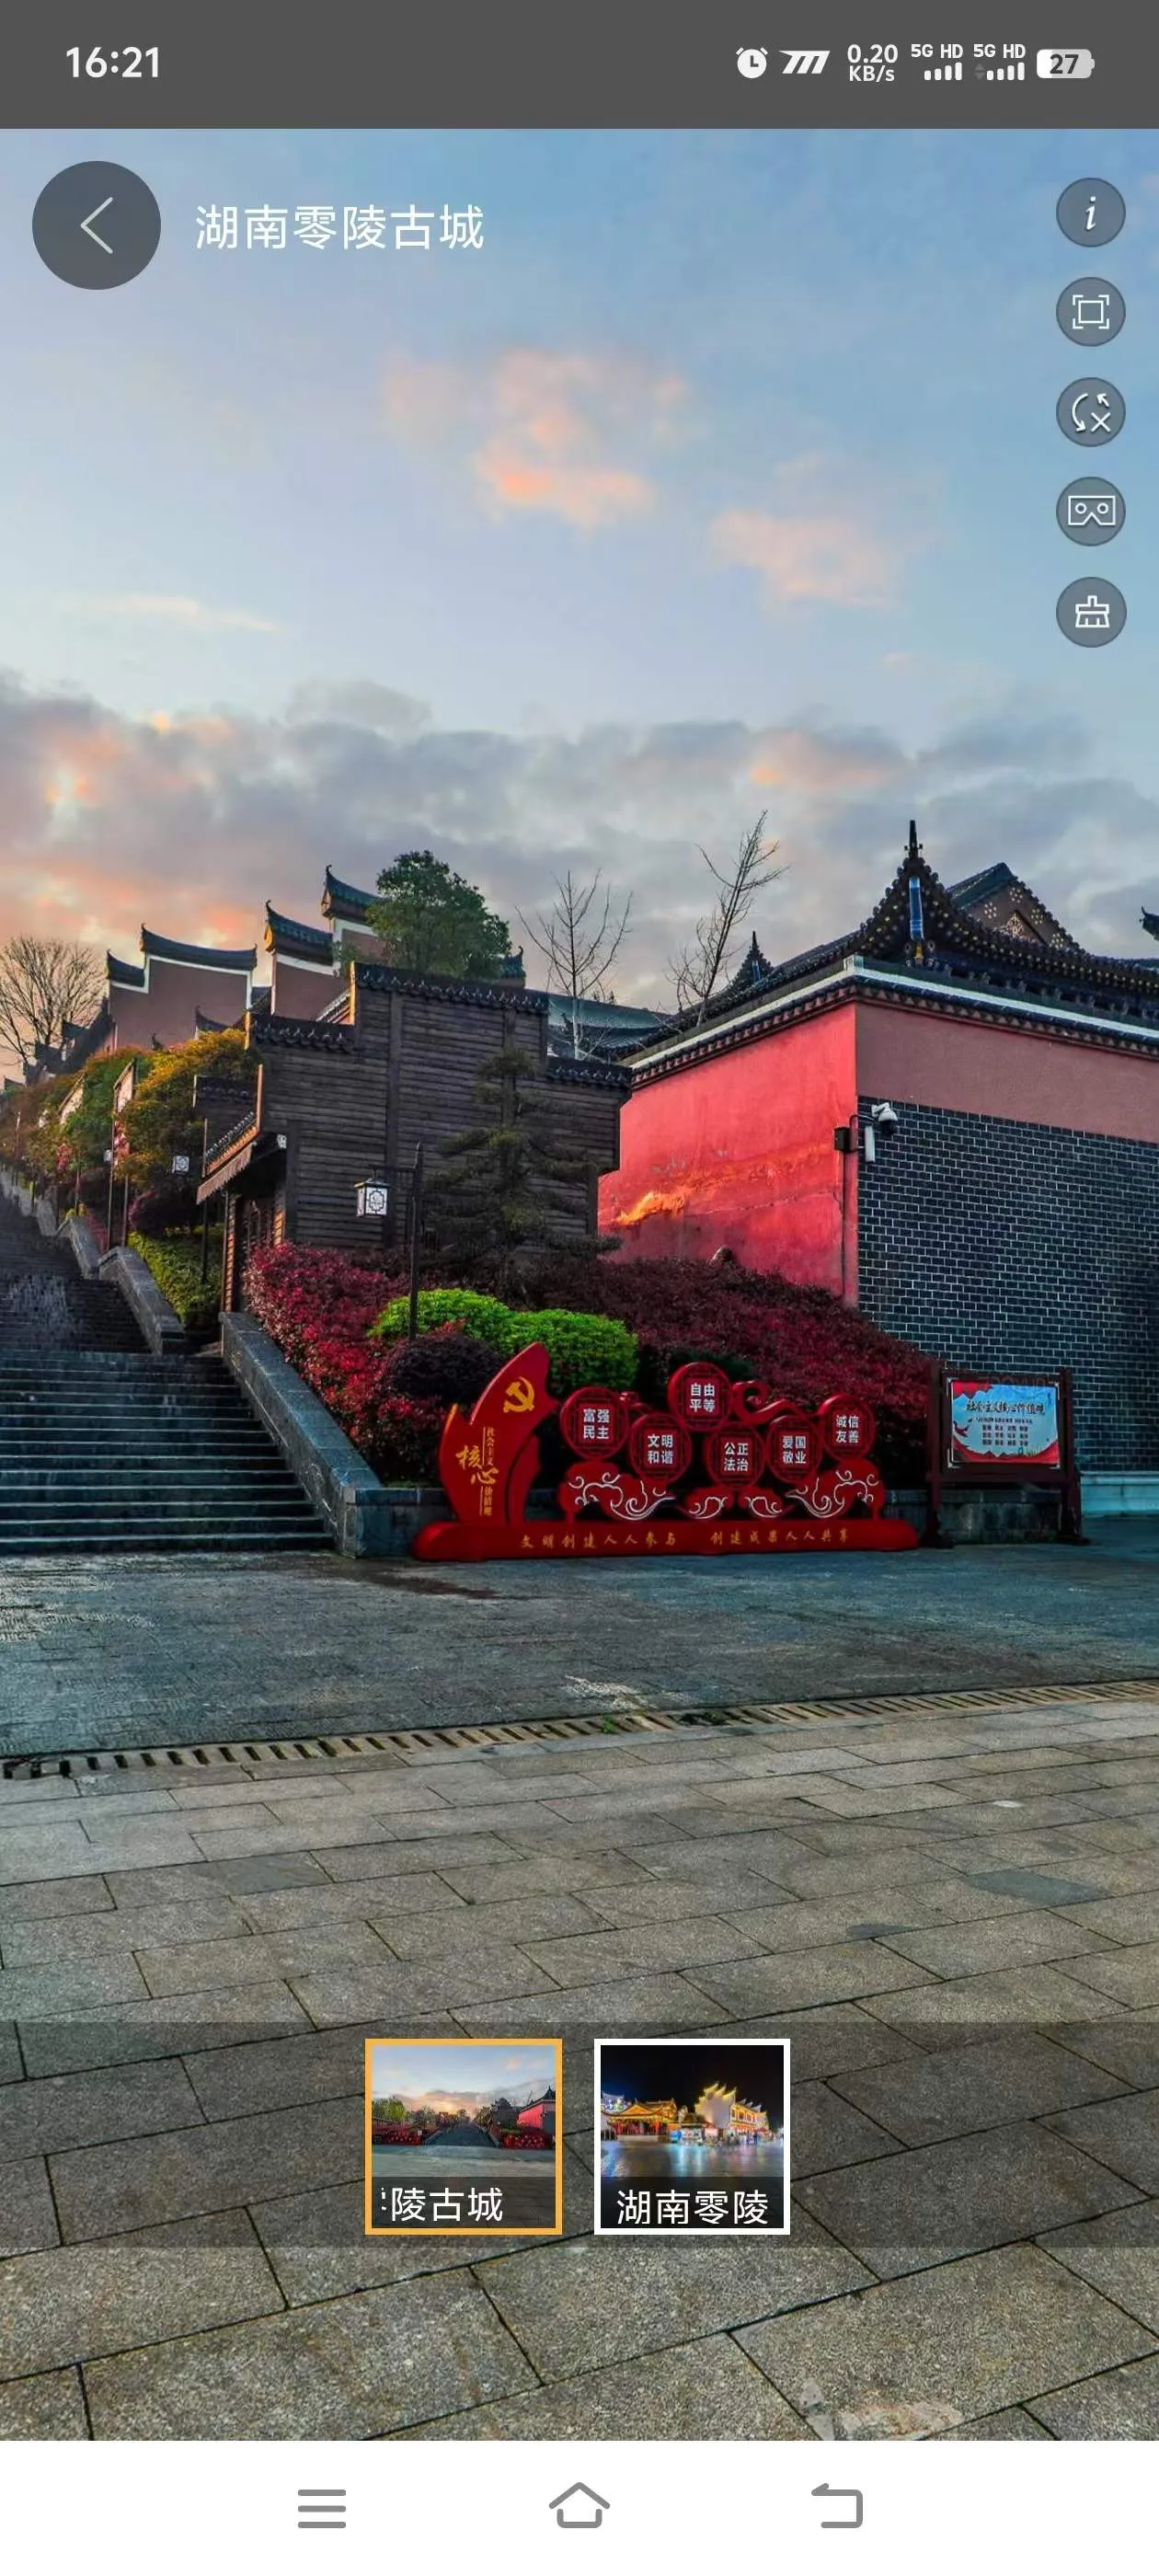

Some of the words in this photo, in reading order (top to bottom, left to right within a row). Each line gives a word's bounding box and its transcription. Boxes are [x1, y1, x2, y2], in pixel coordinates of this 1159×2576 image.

[690, 1382, 716, 1397] 自由
[690, 1398, 715, 1413] 平等
[583, 1409, 610, 1424] 富强
[836, 1414, 859, 1429] 诚信
[583, 1425, 610, 1440] 民主
[836, 1430, 859, 1444] 友善
[647, 1433, 674, 1448] 文明
[782, 1435, 807, 1450] 爱国
[723, 1442, 749, 1456] 公正
[647, 1450, 674, 1466] 和谐
[723, 1457, 749, 1472] 法治
[782, 1451, 807, 1465] 敬业
